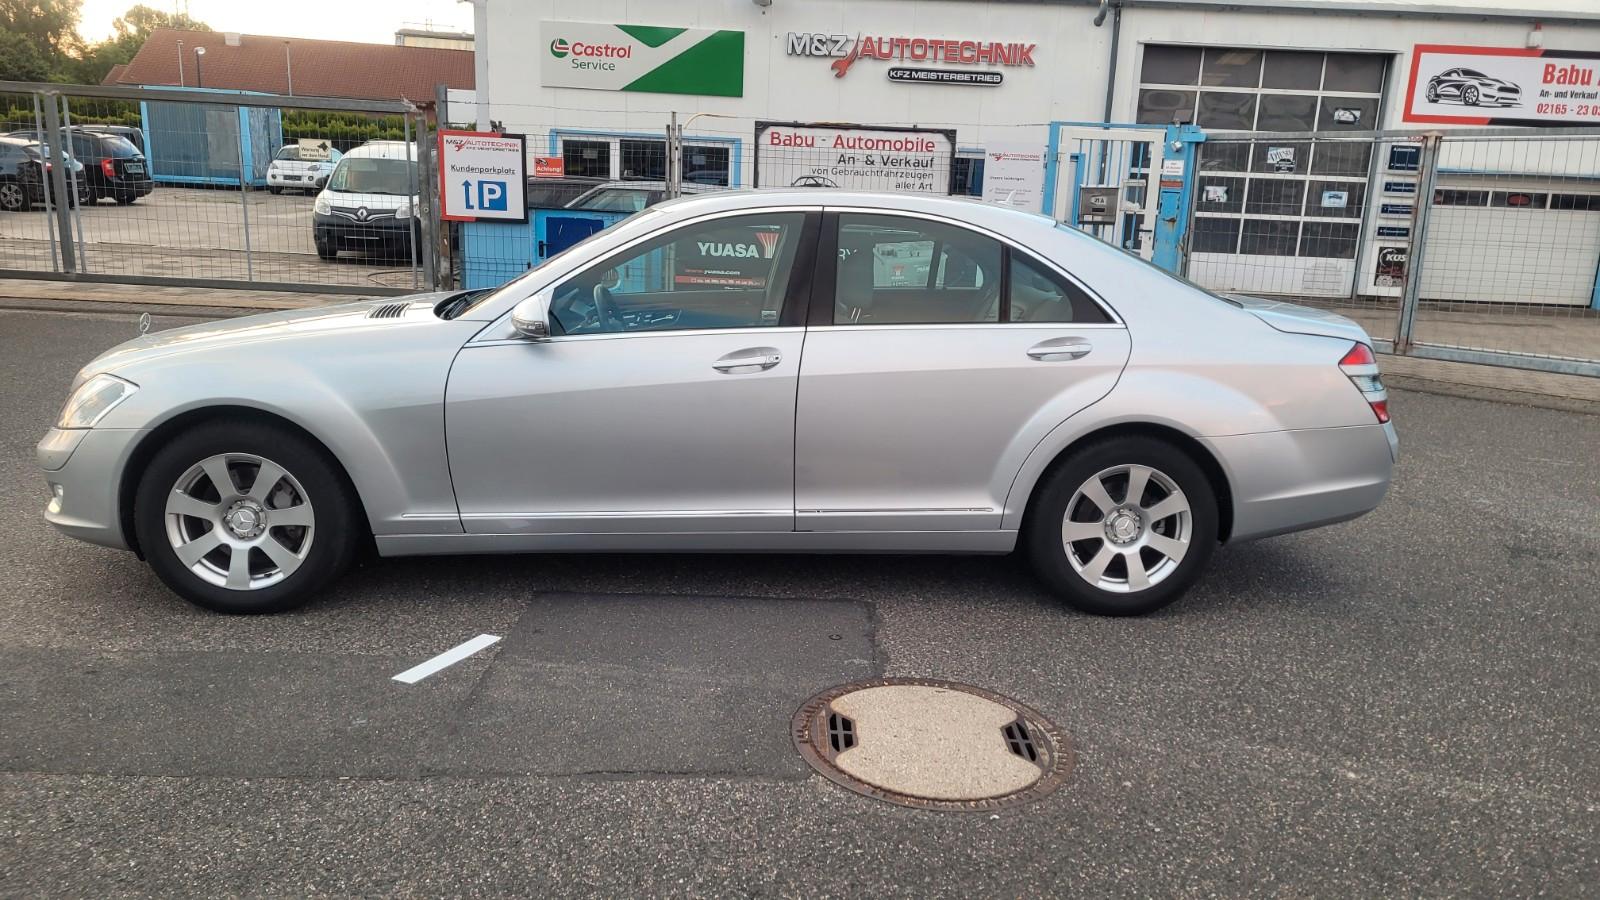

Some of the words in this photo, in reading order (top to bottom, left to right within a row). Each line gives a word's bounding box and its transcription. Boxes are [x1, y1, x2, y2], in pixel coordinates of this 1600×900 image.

[572, 42, 631, 58] Castrol
[787, 32, 848, 57] M&Z
[858, 36, 1036, 66] AUTOTECHNIK
[572, 59, 615, 71] Service
[889, 70, 910, 79] KFZ
[911, 71, 1001, 83] MEISTERBETRIEB
[1542, 64, 1592, 86] Babu
[1539, 89, 1552, 98] An-
[1554, 90, 1568, 98] und
[1570, 90, 1598, 99] Verkauf
[1537, 103, 1567, 115] 02165
[1576, 105, 1589, 115] 23
[466, 139, 520, 148] AUTOTECHNIK
[770, 131, 815, 148] Babu
[833, 135, 935, 153] Automobile
[838, 154, 859, 165] An-
[865, 154, 875, 166] &
[881, 155, 934, 168] Verkauf
[450, 164, 516, 175] Kundenparkplatz
[831, 167, 934, 180] Gebrauchtfahrzeugen
[895, 182, 915, 190] aller
[918, 182, 933, 190] Art
[482, 183, 502, 208] P
[697, 241, 759, 258] YUASA
